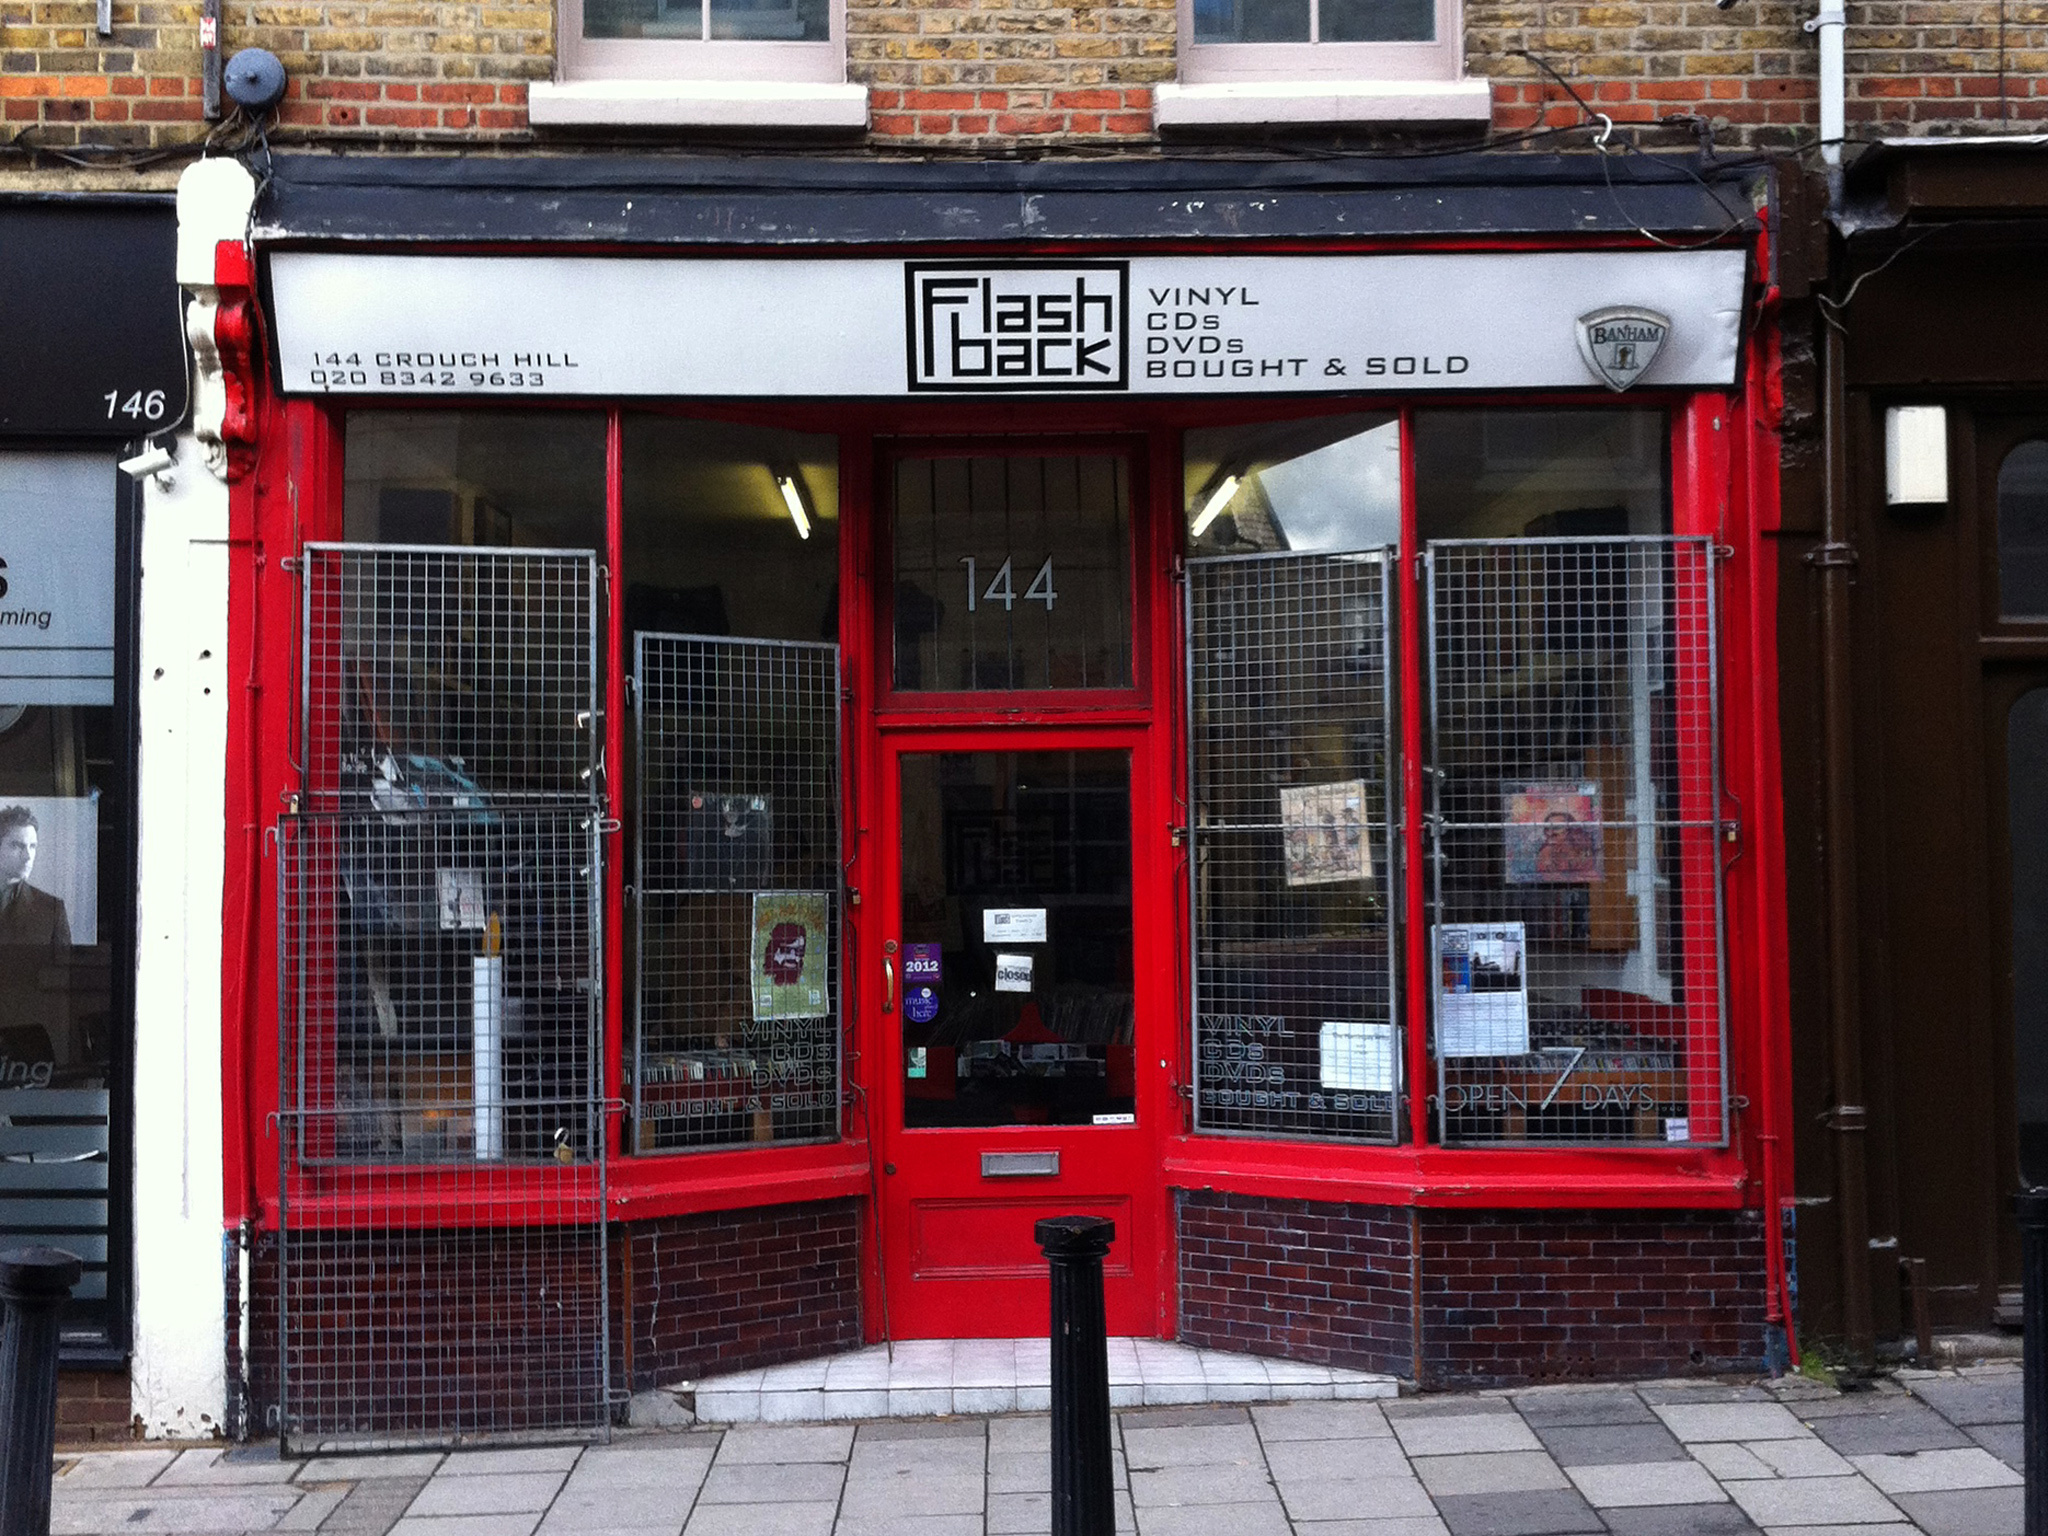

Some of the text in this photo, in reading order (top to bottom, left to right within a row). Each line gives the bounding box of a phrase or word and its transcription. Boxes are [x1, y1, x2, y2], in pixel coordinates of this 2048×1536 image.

[1148, 287, 1259, 306] VINYL
[922, 277, 1112, 376] Flash
[1147, 312, 1220, 331] CDs
[951, 312, 1112, 377] back
[1146, 336, 1244, 355] DVDs
[1594, 325, 1659, 344] BANHAM
[313, 352, 580, 368] 144 CROUCH HILL
[1146, 356, 1469, 378] BOUGHT & SOLD
[310, 370, 545, 387] 020 8342 9633
[104, 389, 166, 419] 146
[958, 552, 1058, 611] 144
[905, 960, 939, 972] 2012
[741, 1017, 832, 1042] VINYL
[1202, 1015, 1295, 1037] VINYL
[1442, 1084, 1527, 1112] OPEN
[1541, 1047, 1587, 1110] 7
[744, 1095, 764, 1113] &
[772, 1092, 834, 1109] SOLD
[1202, 1088, 1300, 1108] BOUGHT
[1308, 1092, 1327, 1110] &
